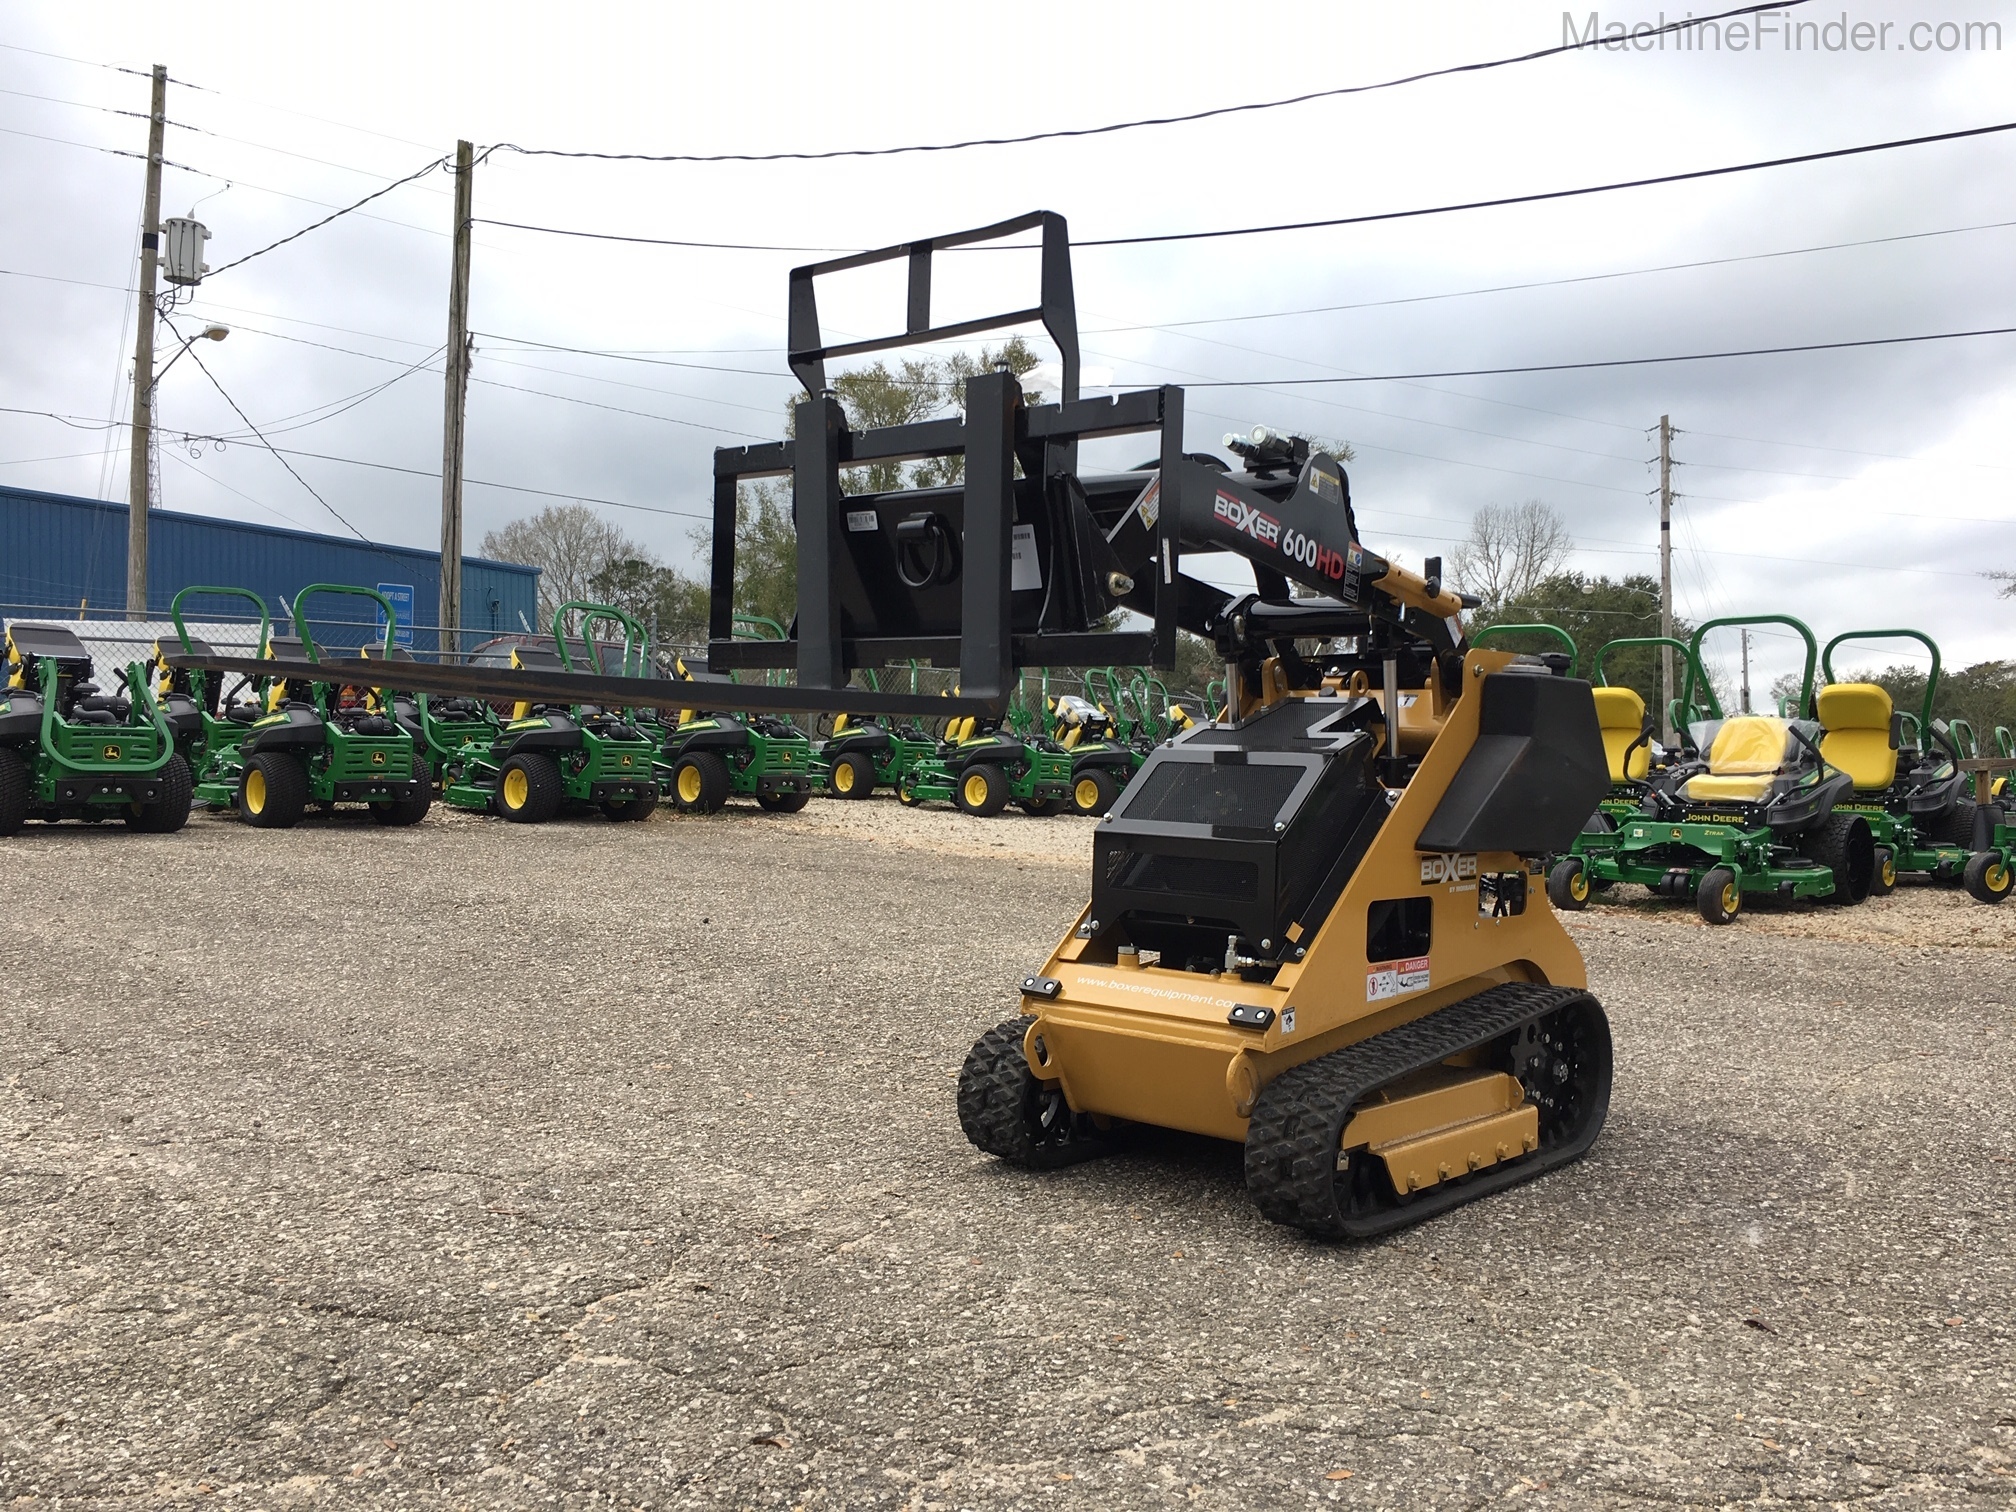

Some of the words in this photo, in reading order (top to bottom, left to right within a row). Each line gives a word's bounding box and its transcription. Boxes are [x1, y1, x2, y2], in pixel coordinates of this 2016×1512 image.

[1214, 494, 1279, 544] BOXER
[1613, 798, 1640, 806] DEERE
[1854, 803, 1885, 812] DEERE
[1685, 813, 1712, 823] JOHN
[1712, 814, 1745, 824] DEERE
[1421, 853, 1477, 884] BOXER
[1405, 959, 1428, 971] DANGER
